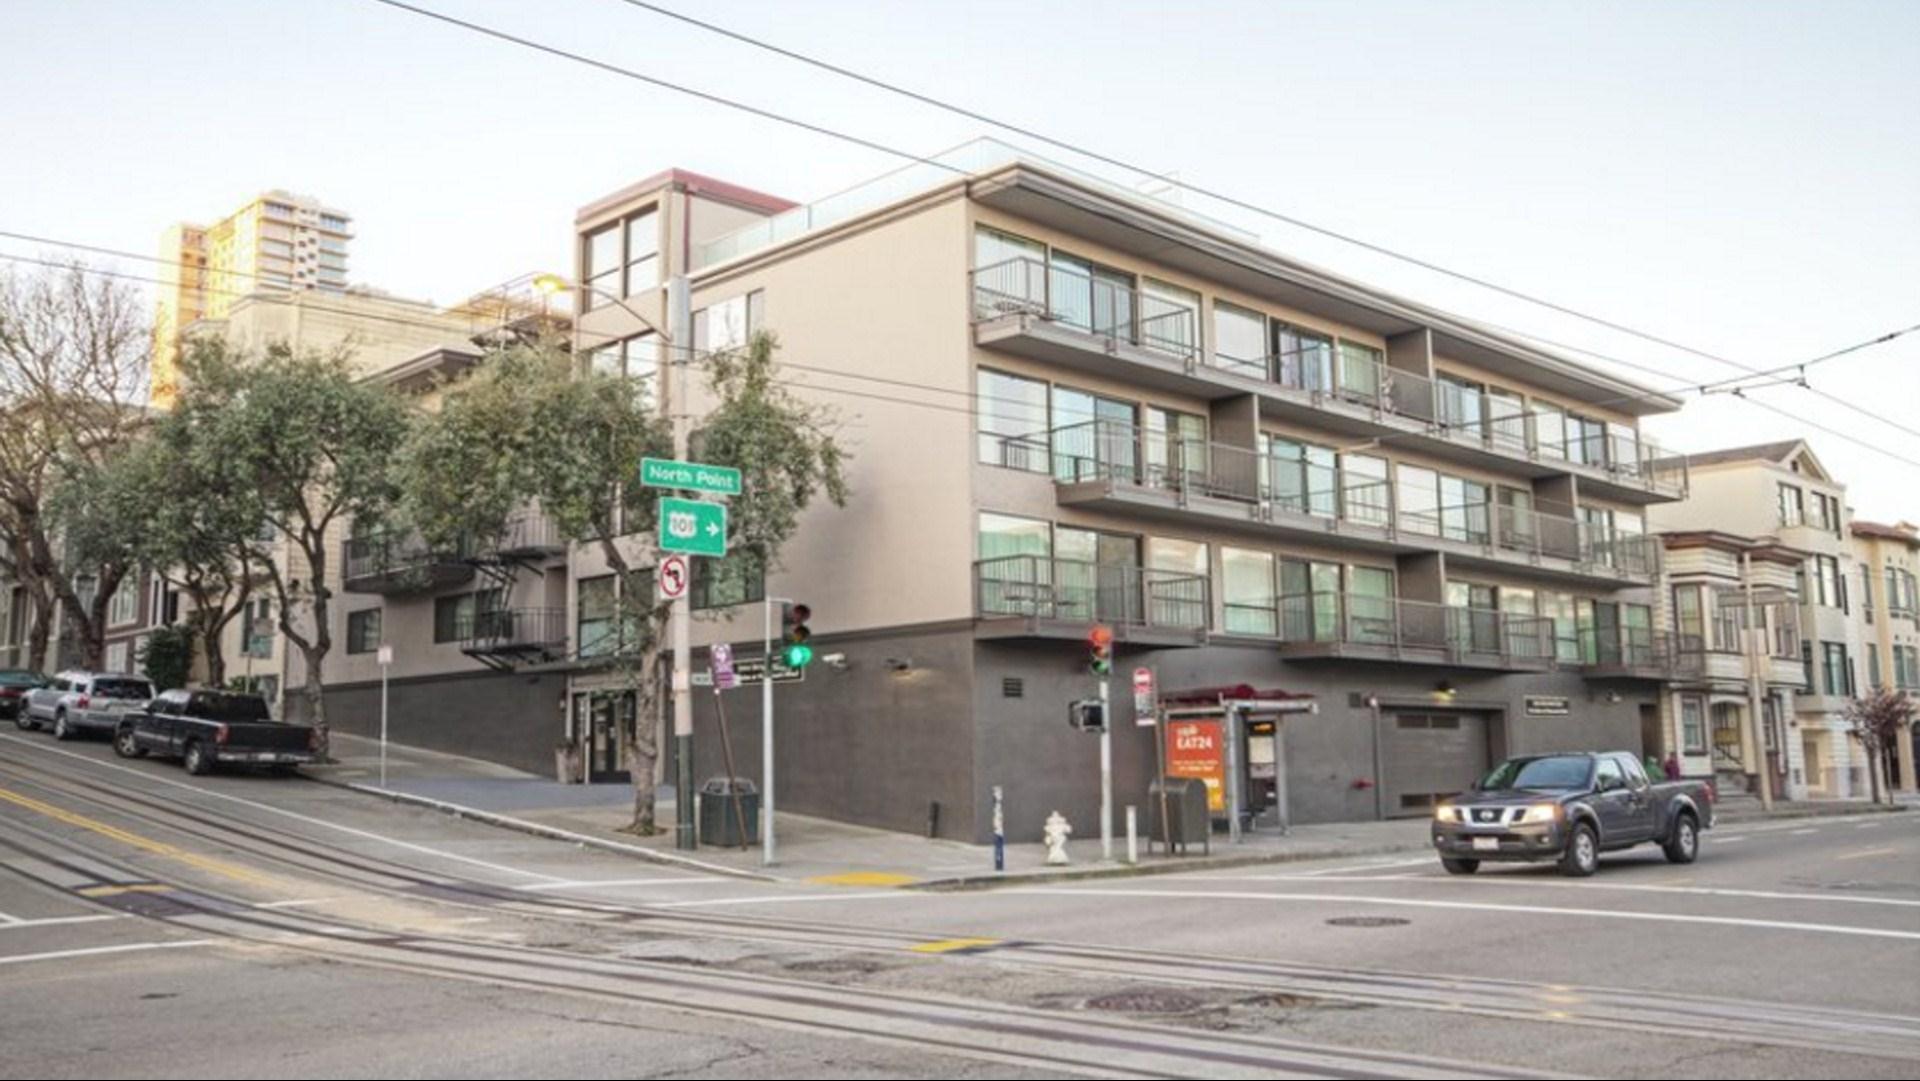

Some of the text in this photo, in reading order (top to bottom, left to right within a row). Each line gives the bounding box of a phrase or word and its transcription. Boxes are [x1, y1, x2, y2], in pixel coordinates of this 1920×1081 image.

[649, 464, 734, 489] North Point
[672, 516, 694, 533] 101
